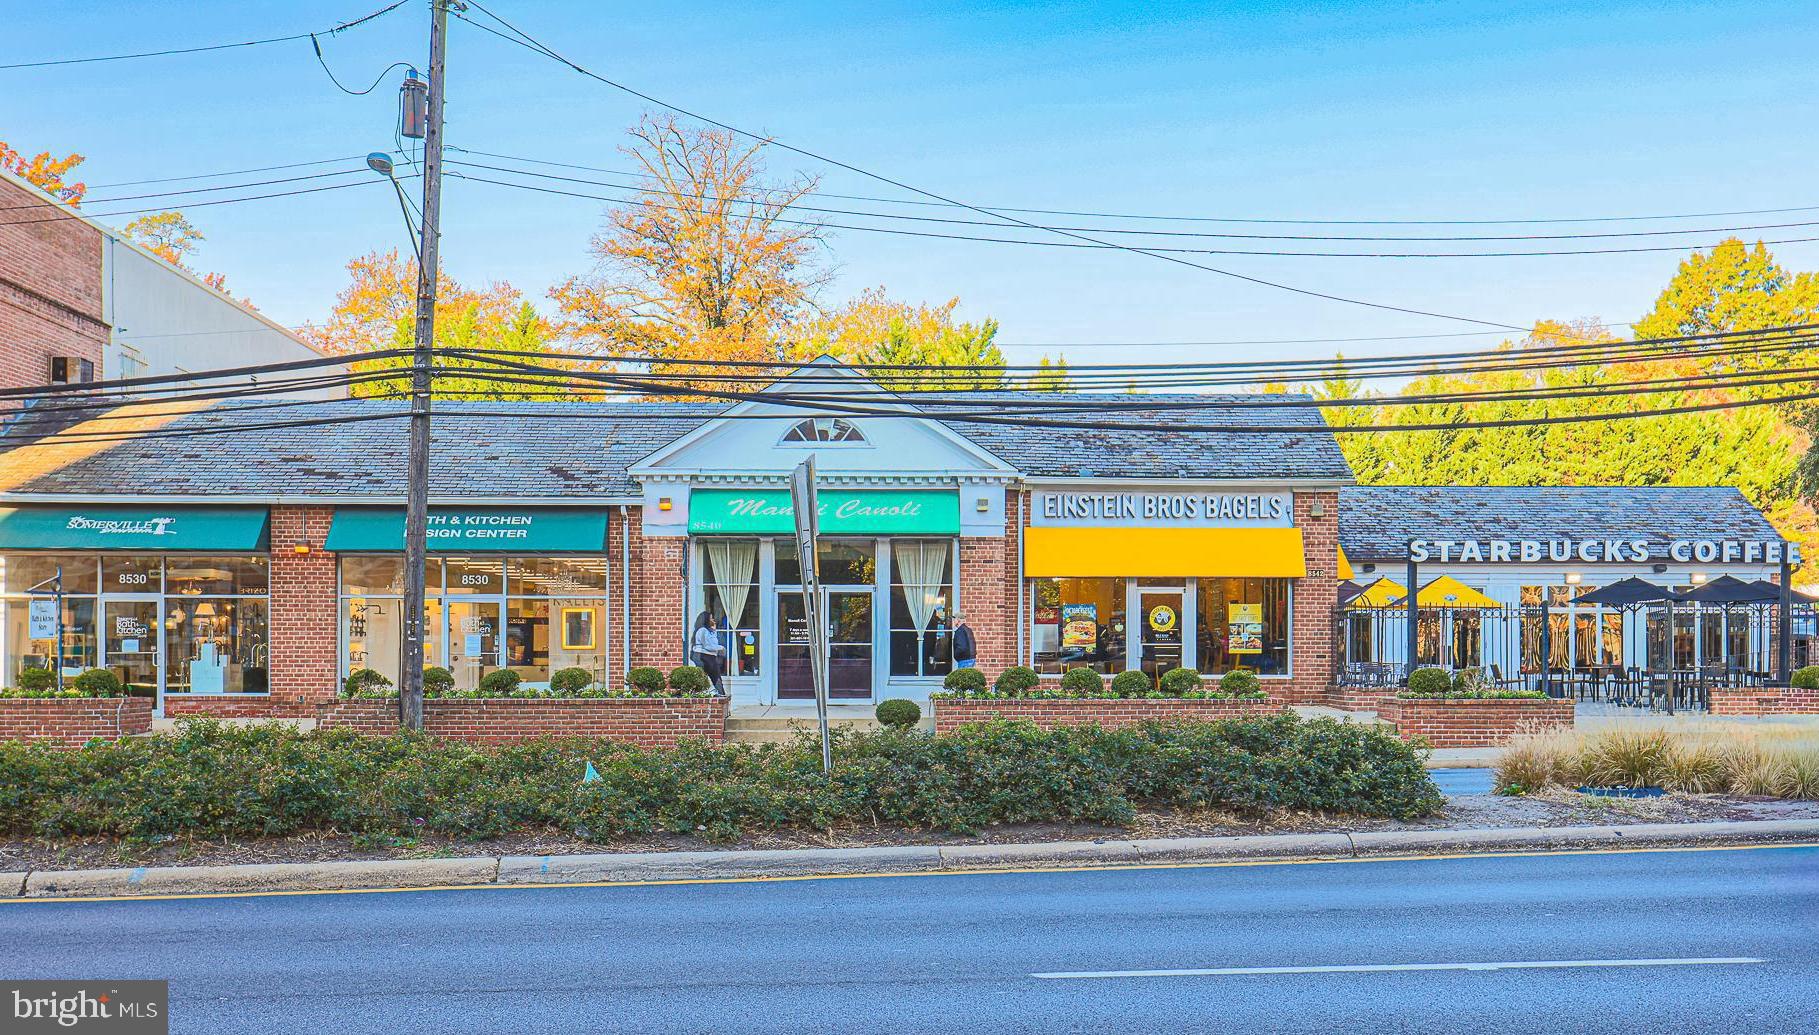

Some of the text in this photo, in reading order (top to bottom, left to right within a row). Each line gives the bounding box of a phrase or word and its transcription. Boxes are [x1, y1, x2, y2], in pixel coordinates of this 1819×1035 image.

[728, 499, 922, 519] Mani Canoli
[1044, 495, 1284, 518] EINSTEIN BROS BAGELS
[66, 518, 153, 529] SOMERVILLE
[405, 516, 532, 525] TH & KITCHEN
[404, 529, 528, 538] SIGN CENTER
[1410, 540, 1802, 564] STARBUCKS COFFEE
[118, 574, 147, 584] 8530
[461, 575, 489, 585] 8530
